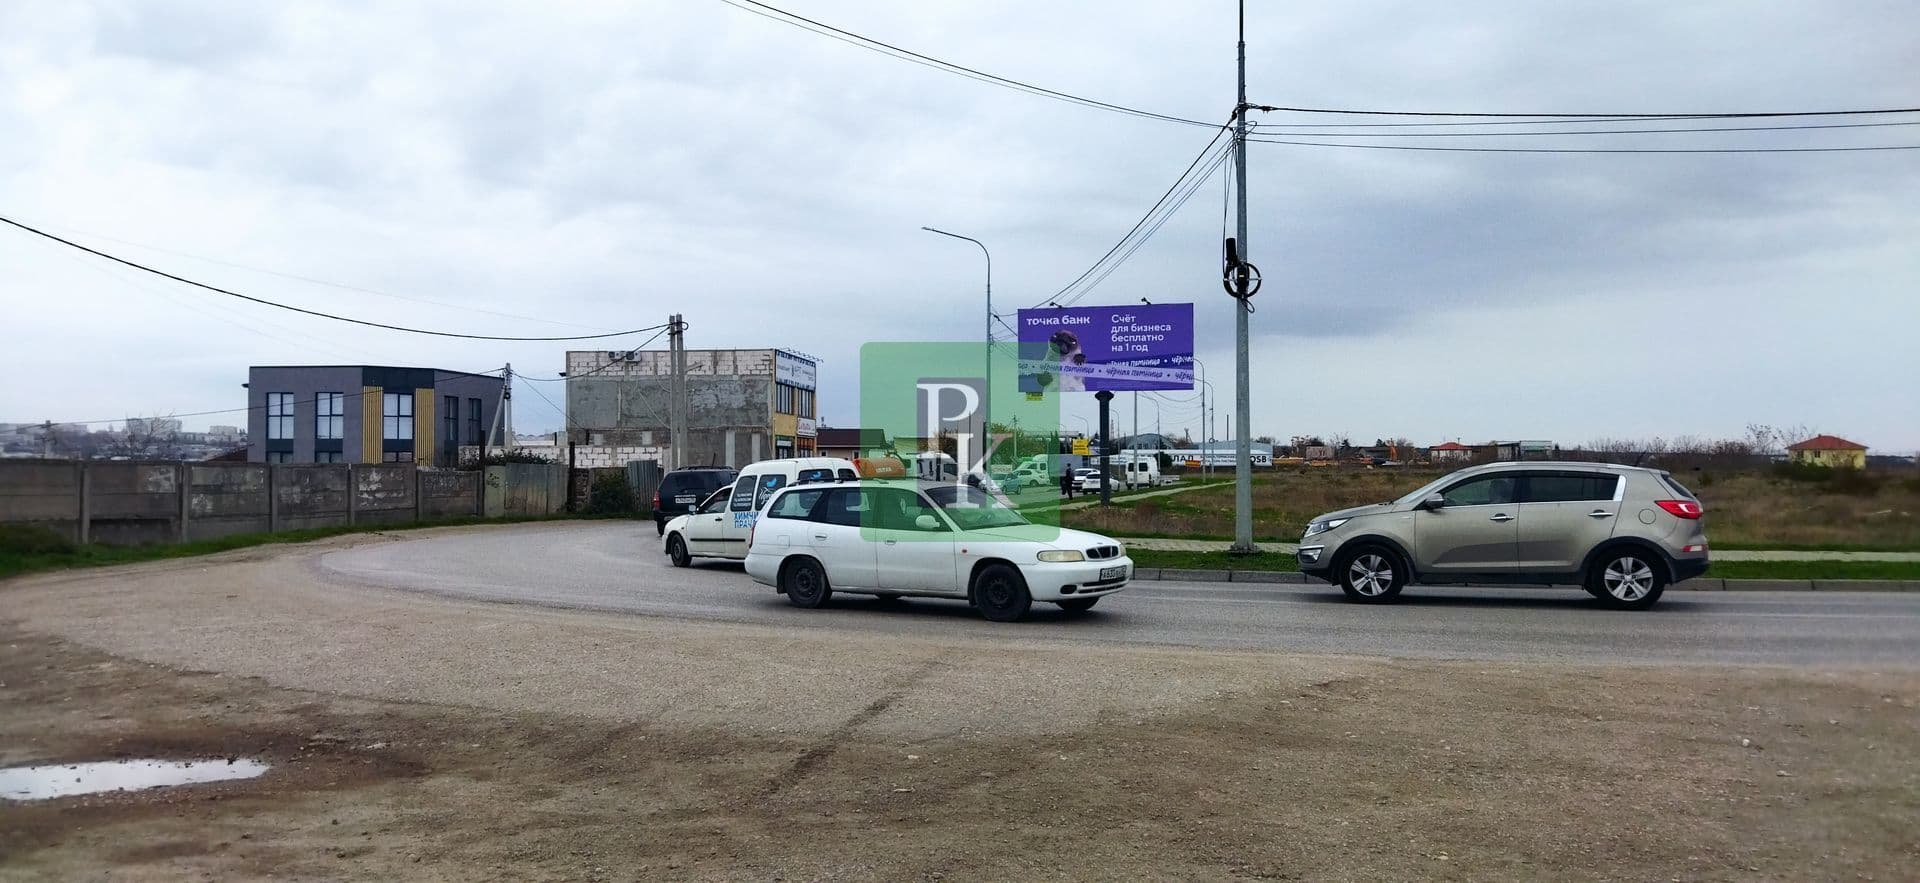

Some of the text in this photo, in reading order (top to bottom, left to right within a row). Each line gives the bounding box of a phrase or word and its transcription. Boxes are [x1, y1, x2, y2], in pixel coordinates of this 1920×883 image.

[1026, 315, 1091, 326] точка банк
[1111, 313, 1136, 323] Счёт
[1111, 323, 1171, 333] для бизнеса
[1111, 333, 1164, 342] бесплатно
[1125, 343, 1129, 351] 1
[1131, 344, 1148, 352] год
[1106, 368, 1130, 377] чёрная
[1131, 370, 1163, 378] пятница
[1250, 455, 1267, 463] OSB
